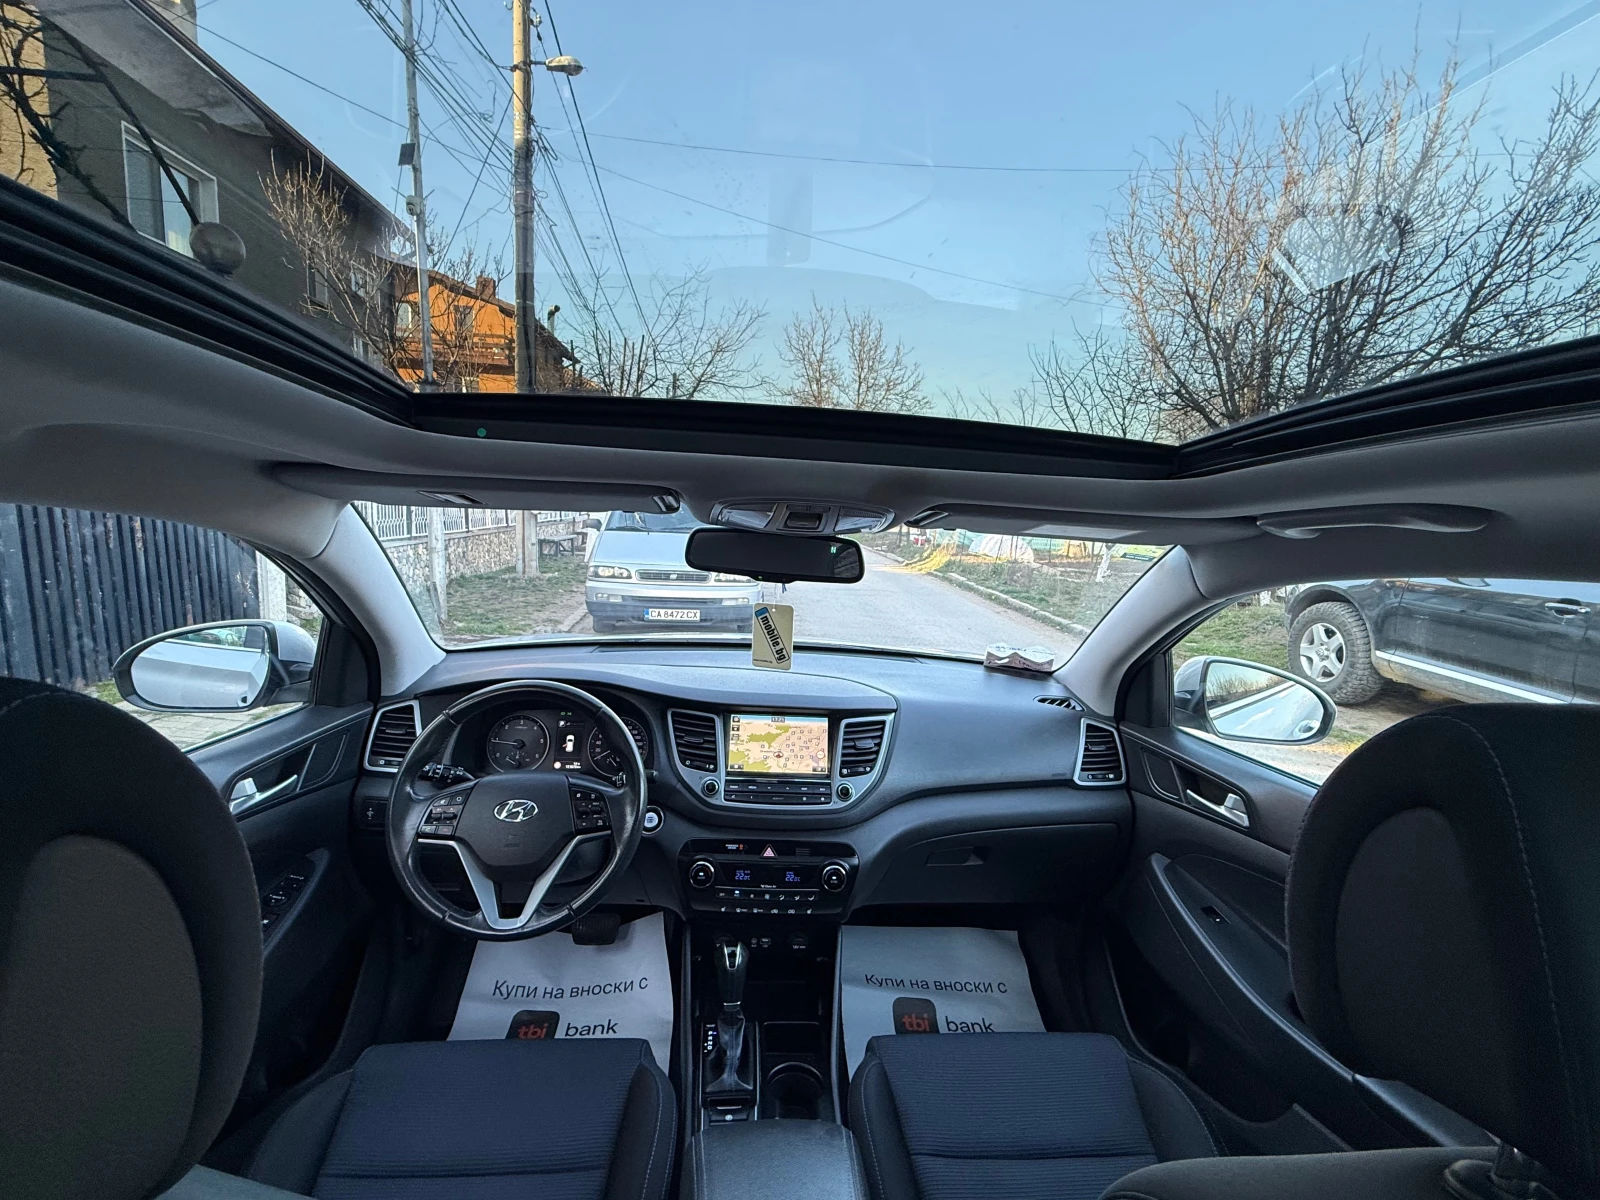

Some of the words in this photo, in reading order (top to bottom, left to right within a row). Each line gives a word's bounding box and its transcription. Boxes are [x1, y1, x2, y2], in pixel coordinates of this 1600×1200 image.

[650, 610, 662, 618] CA
[663, 610, 685, 619] 8472
[686, 611, 698, 619] CX
[760, 615, 787, 662] mobile.bg
[492, 980, 538, 1000] Купи
[542, 986, 564, 999] на
[569, 980, 634, 998] вноски
[638, 977, 648, 990] с
[865, 974, 905, 988] Купи
[910, 979, 930, 990] на
[933, 980, 993, 993] вноски
[997, 982, 1008, 994] с
[517, 1023, 549, 1039] tbi
[565, 1019, 618, 1037] bank
[902, 1013, 930, 1032] tbi
[945, 1016, 995, 1033] bank
